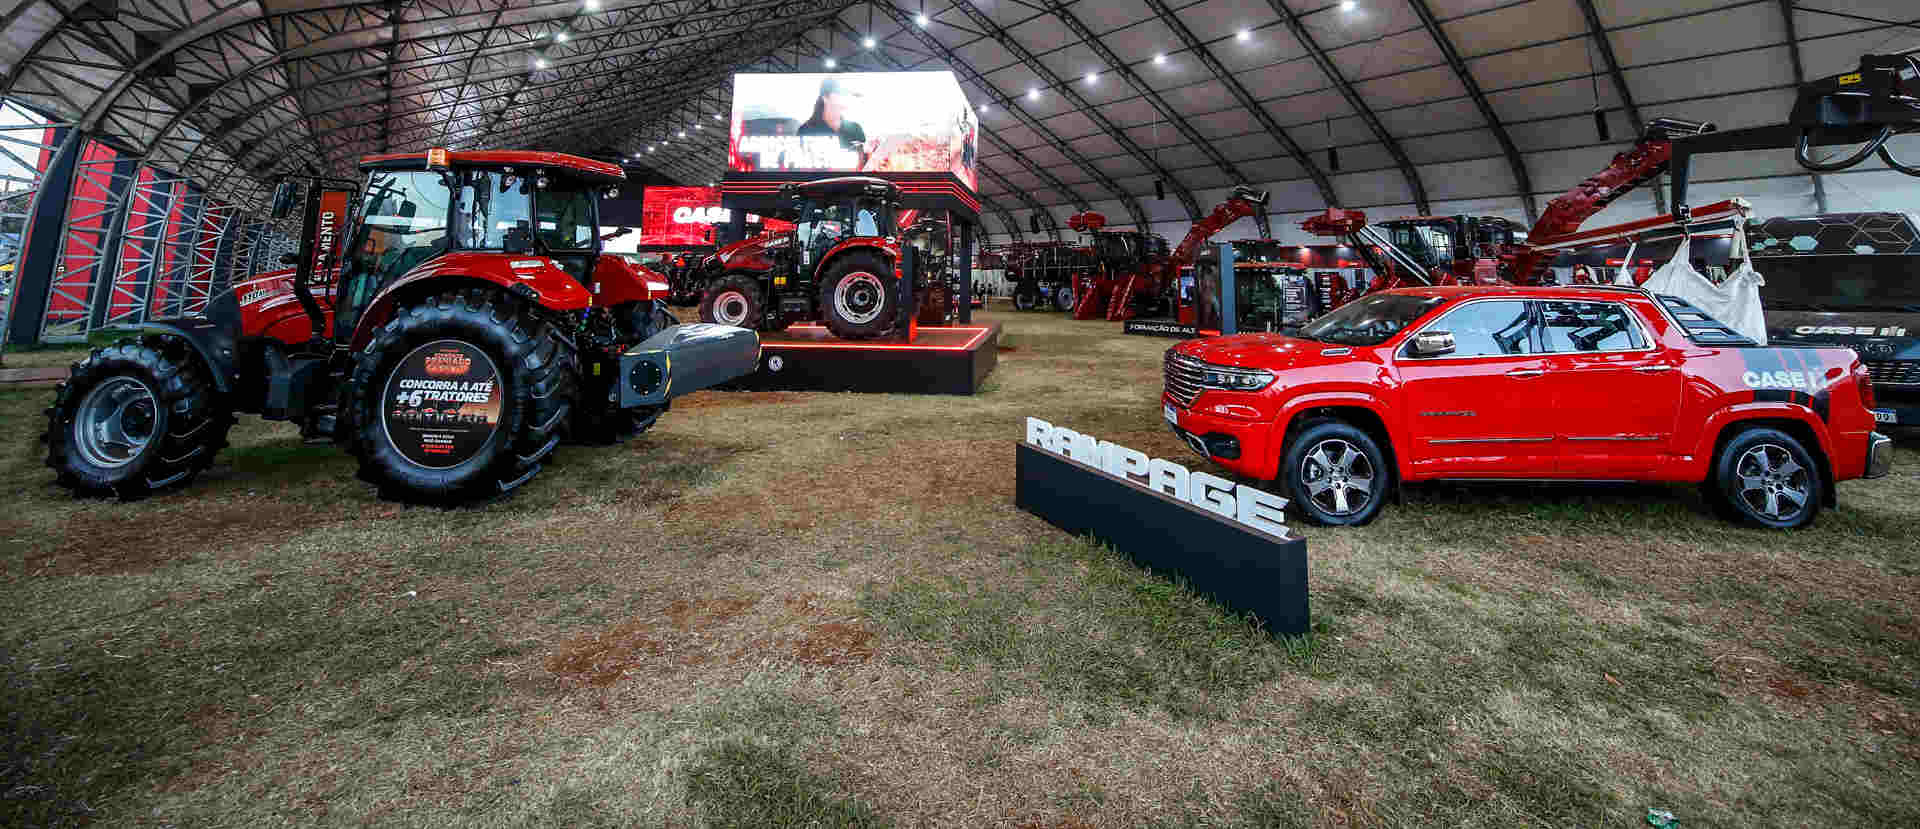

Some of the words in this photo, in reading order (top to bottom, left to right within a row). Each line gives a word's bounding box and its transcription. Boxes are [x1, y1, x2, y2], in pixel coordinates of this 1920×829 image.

[1795, 326, 1876, 336] CASE
[400, 379, 458, 392] CONCORRA
[460, 382, 469, 392] A
[1743, 370, 1805, 388] CASE
[424, 391, 489, 403] TRATORES
[1026, 416, 1290, 540] RAMPAGE
